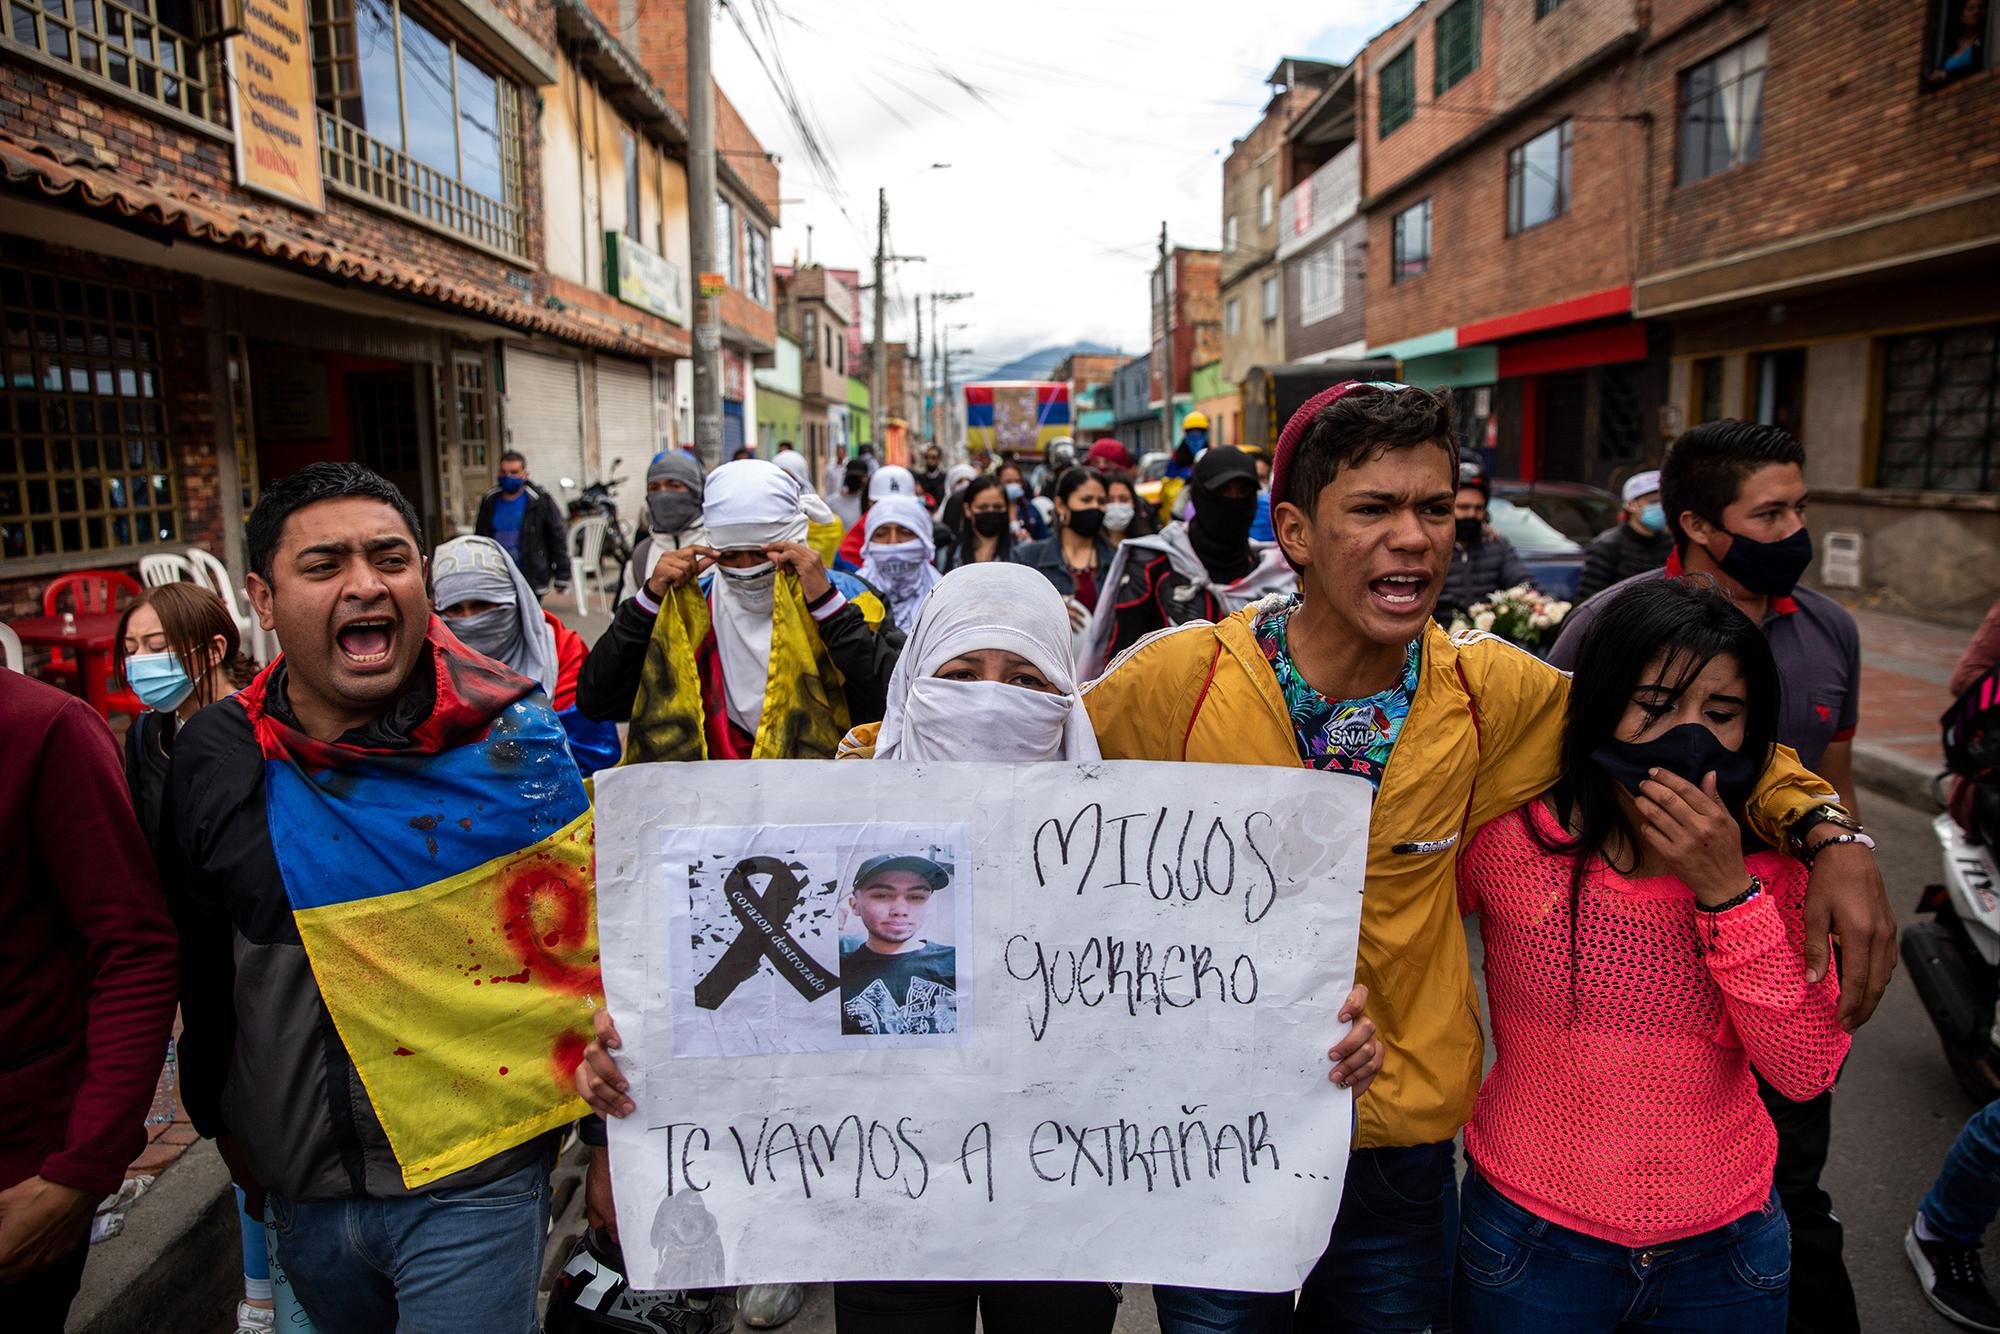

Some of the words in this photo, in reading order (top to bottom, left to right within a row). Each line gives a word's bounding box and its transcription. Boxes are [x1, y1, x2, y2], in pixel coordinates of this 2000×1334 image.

[246, 51, 273, 80] Pata
[248, 82, 299, 119] Costillas
[252, 110, 304, 147] Changua
[1328, 728, 1377, 746] SNAP
[1303, 757, 1384, 776] AR
[1033, 802, 1277, 924] MILLOS
[731, 890, 774, 934] corazon
[771, 933, 827, 992] destrozado
[648, 1121, 711, 1198] TE
[728, 1114, 929, 1200] VAMOS
[953, 1121, 993, 1203] A
